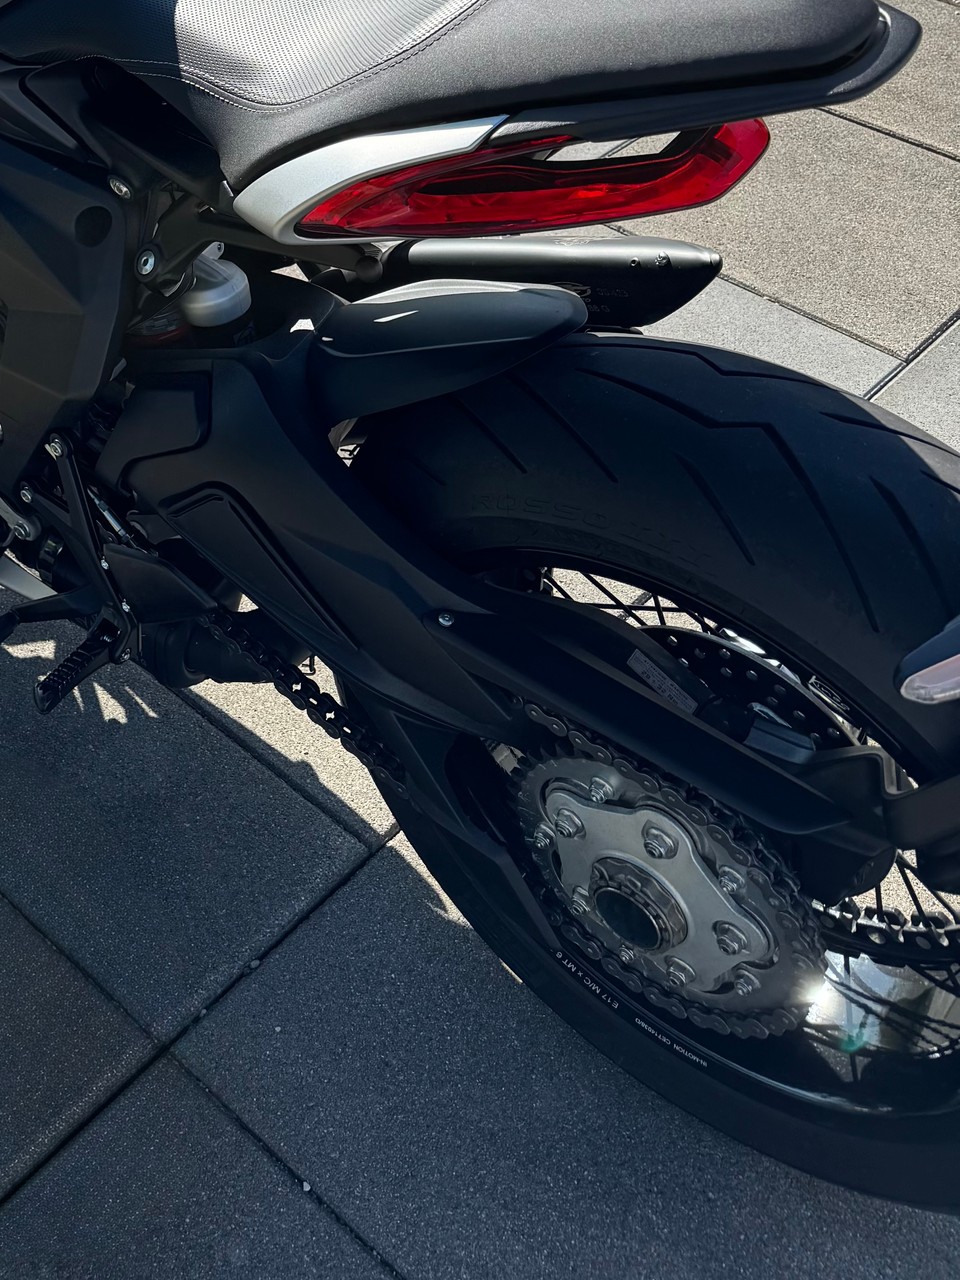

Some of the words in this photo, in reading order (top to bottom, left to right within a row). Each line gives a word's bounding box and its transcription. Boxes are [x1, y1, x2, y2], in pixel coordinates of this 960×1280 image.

[555, 951, 563, 959] 6
[561, 959, 577, 972] MT
[583, 976, 601, 994] M/C
[673, 1043, 708, 1067] IN-MOTION
